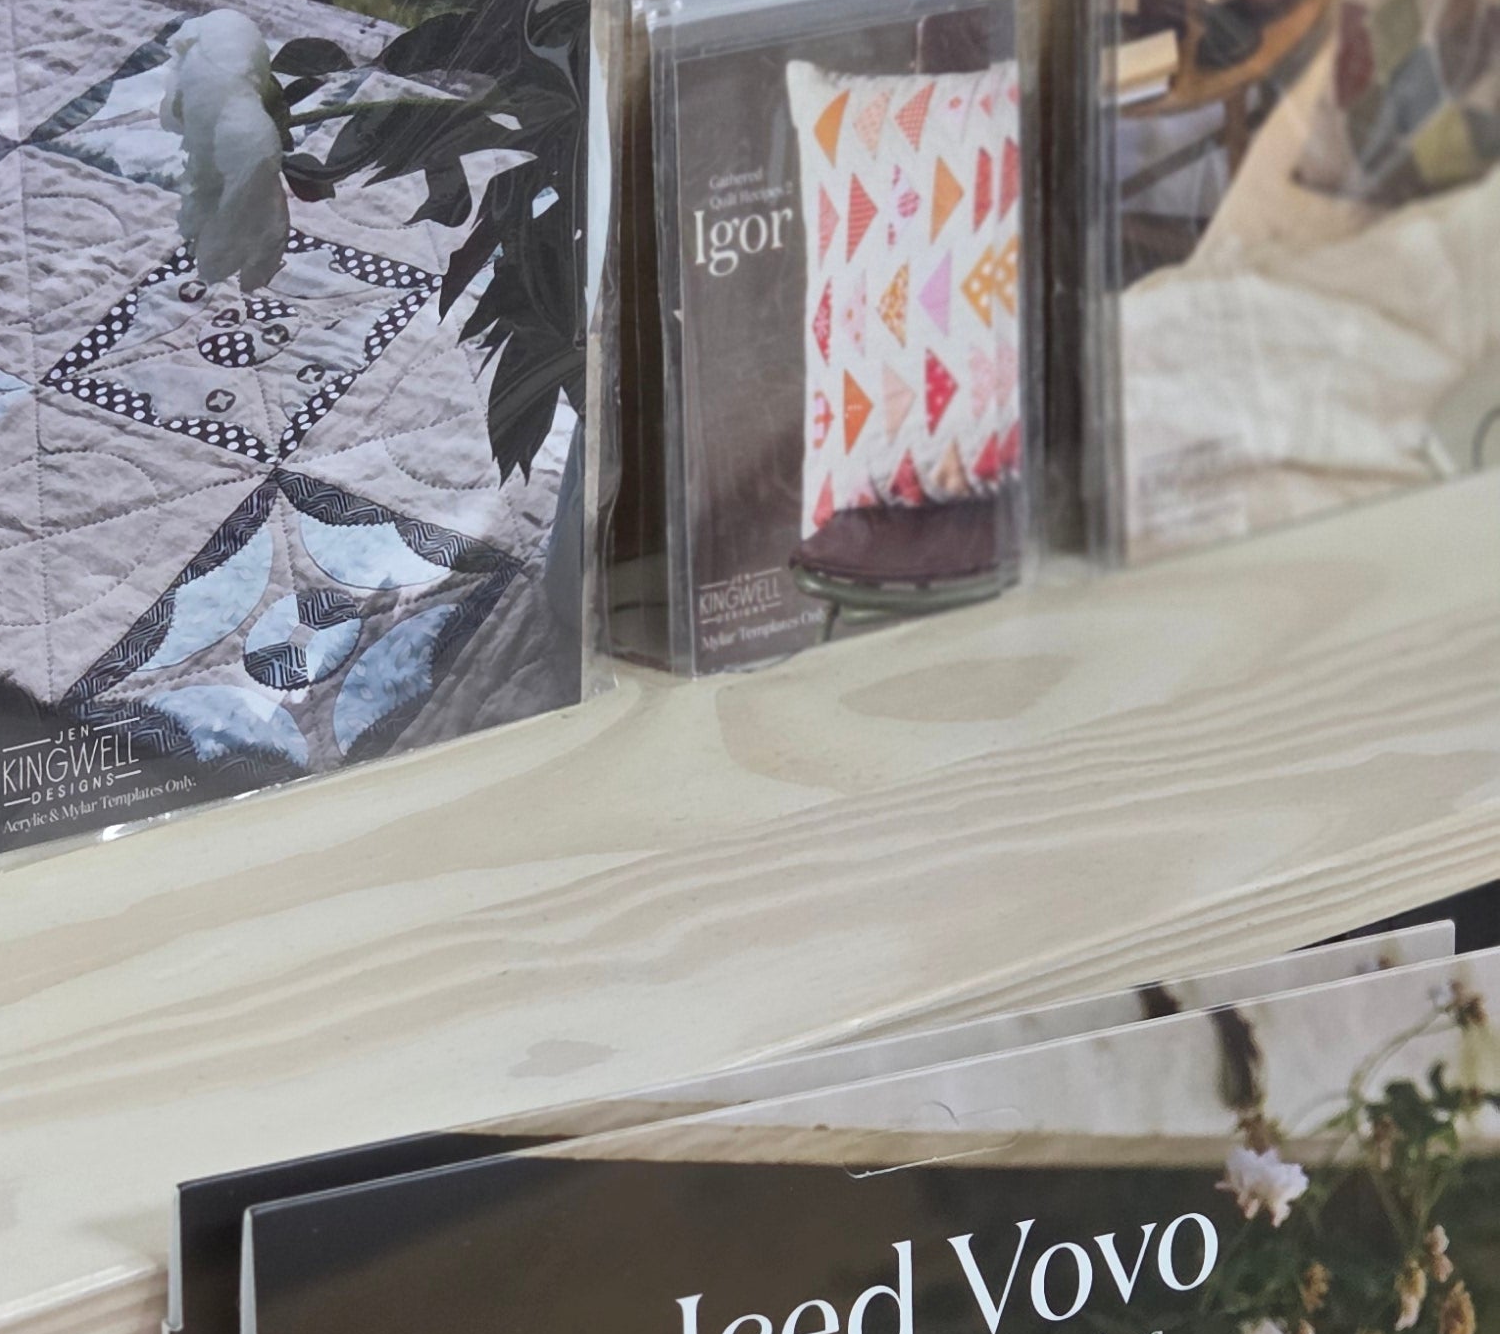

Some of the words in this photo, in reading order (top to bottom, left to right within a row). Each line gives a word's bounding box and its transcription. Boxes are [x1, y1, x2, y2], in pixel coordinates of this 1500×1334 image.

[693, 208, 793, 277] Igor
[700, 576, 781, 616] KINGWELL
[54, 724, 89, 745] JEN
[3, 731, 140, 796] KINGWELL
[2, 811, 48, 835] Acrylic
[49, 807, 62, 823] &
[62, 800, 98, 821] Mylar
[100, 784, 164, 810] Templates
[31, 773, 115, 805] DESIGNS
